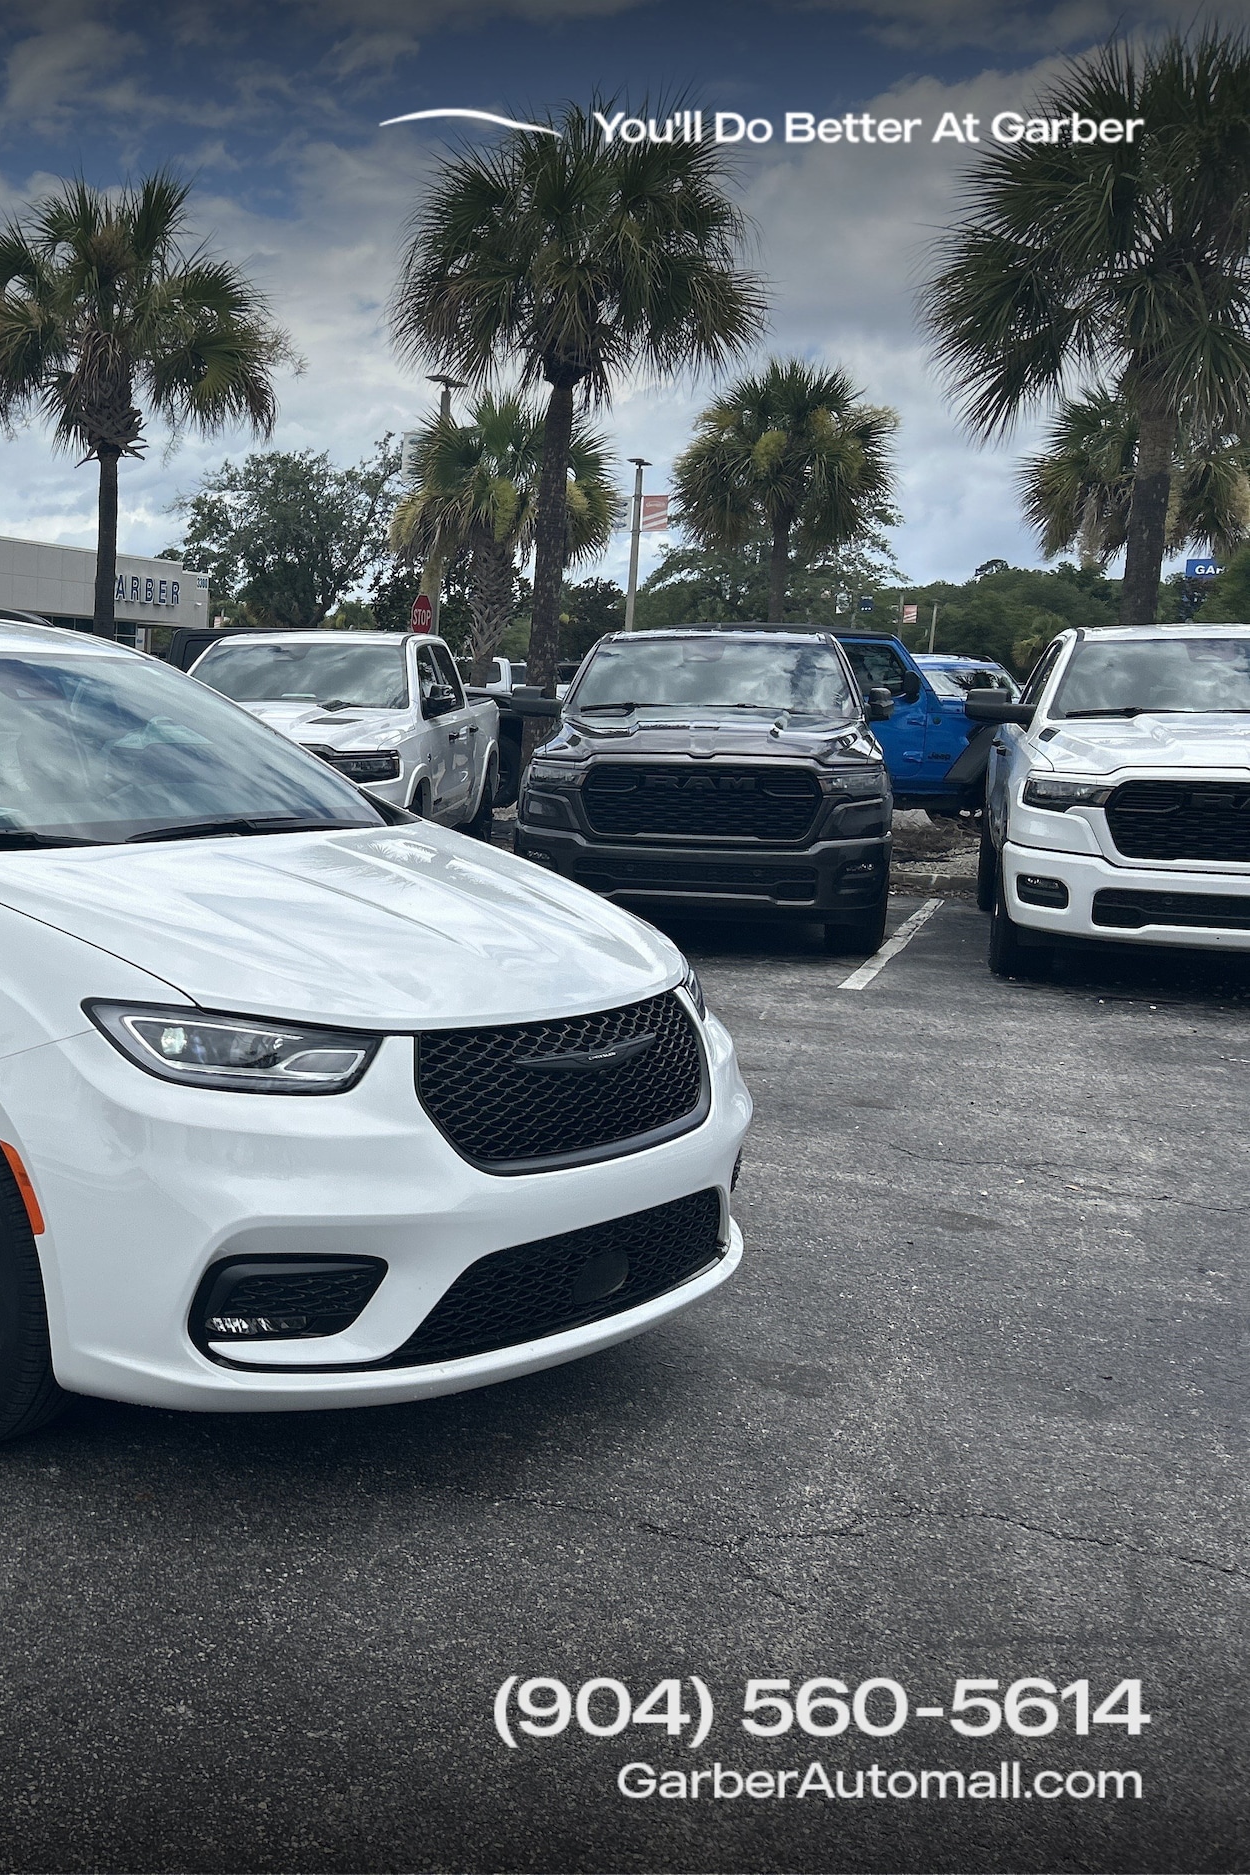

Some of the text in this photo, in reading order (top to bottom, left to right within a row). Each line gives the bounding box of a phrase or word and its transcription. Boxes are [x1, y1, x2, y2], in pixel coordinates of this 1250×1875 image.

[114, 574, 180, 606] ARBER
[412, 608, 431, 626] STOP
[645, 774, 756, 790] RAM
